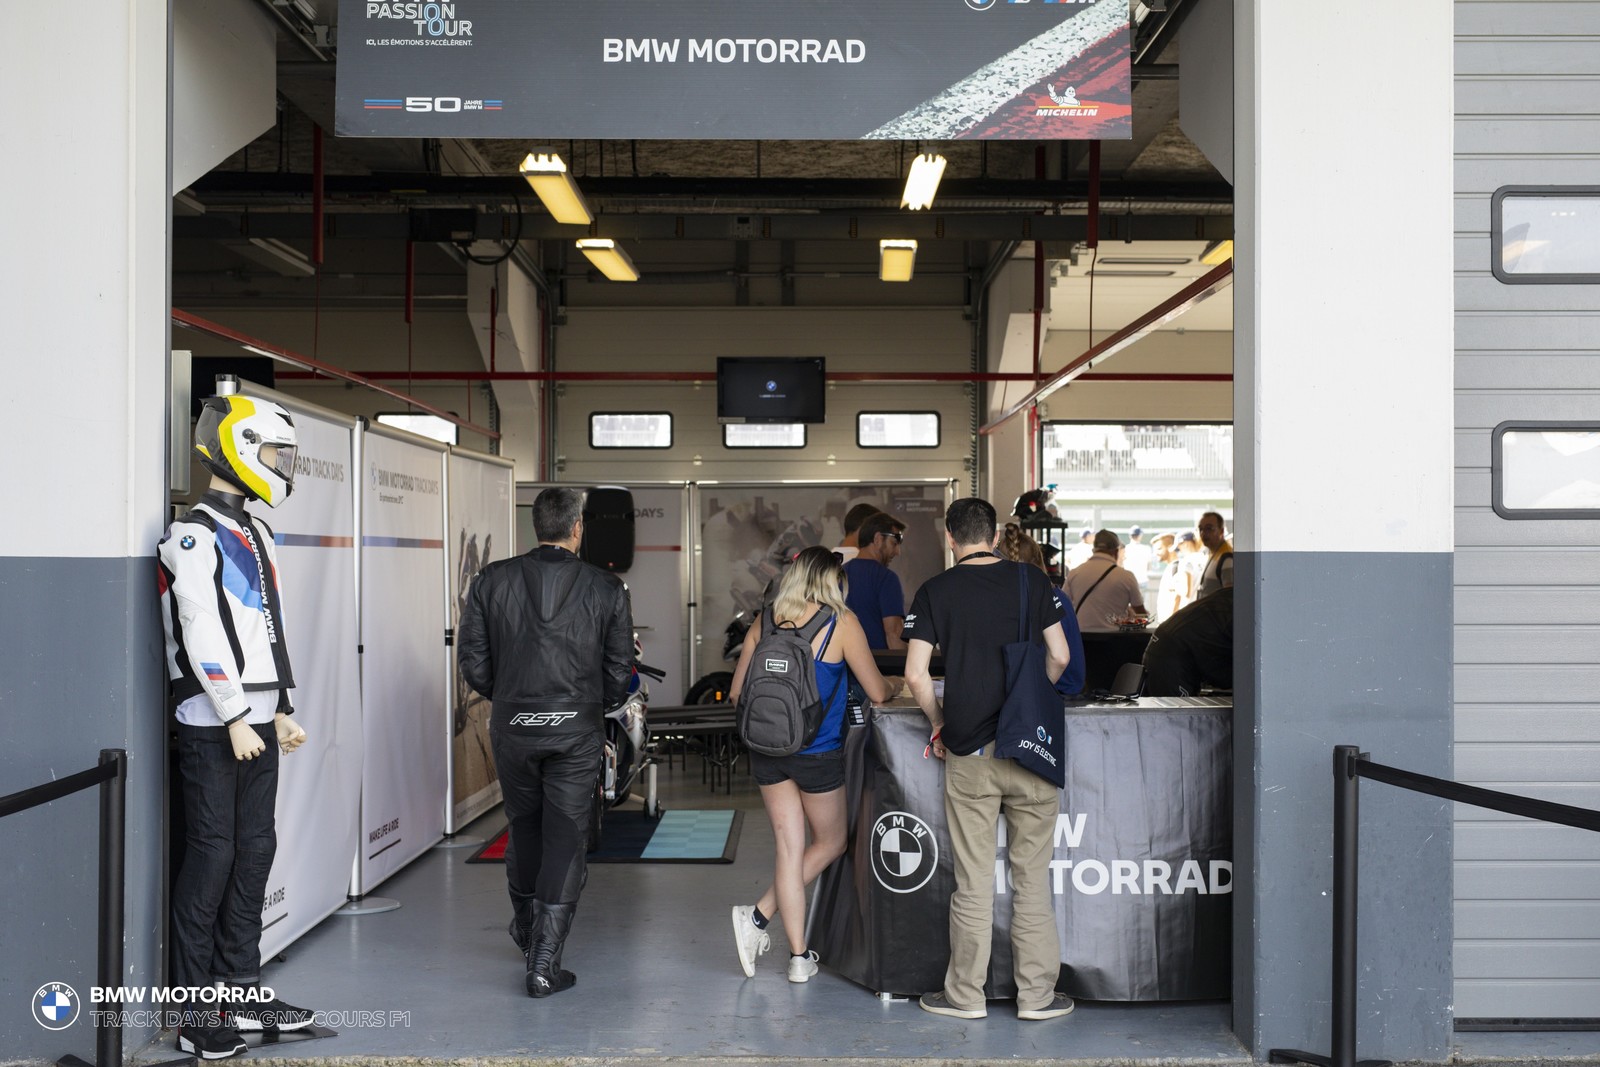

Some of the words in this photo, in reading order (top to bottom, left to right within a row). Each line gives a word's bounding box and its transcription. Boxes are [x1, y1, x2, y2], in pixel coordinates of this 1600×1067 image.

[366, 3, 455, 20] PASSION
[413, 19, 473, 36] TOUR
[391, 38, 424, 46] ÉMOTIONS
[425, 38, 473, 46] S'ACCÉLÈRENT.
[603, 39, 680, 62] BMW
[688, 39, 866, 63] MOTORRAD
[406, 97, 461, 112] 50
[1036, 109, 1098, 117] MICHELIN
[311, 458, 331, 480] TRACK
[331, 461, 344, 482] DAYS
[242, 526, 268, 605] MOTORRAD
[263, 606, 277, 644] BMW
[510, 711, 578, 726] RST
[1018, 739, 1035, 750] JOY
[1034, 744, 1041, 754] IS
[876, 815, 927, 839] BMW
[994, 858, 1232, 895] TORRAD
